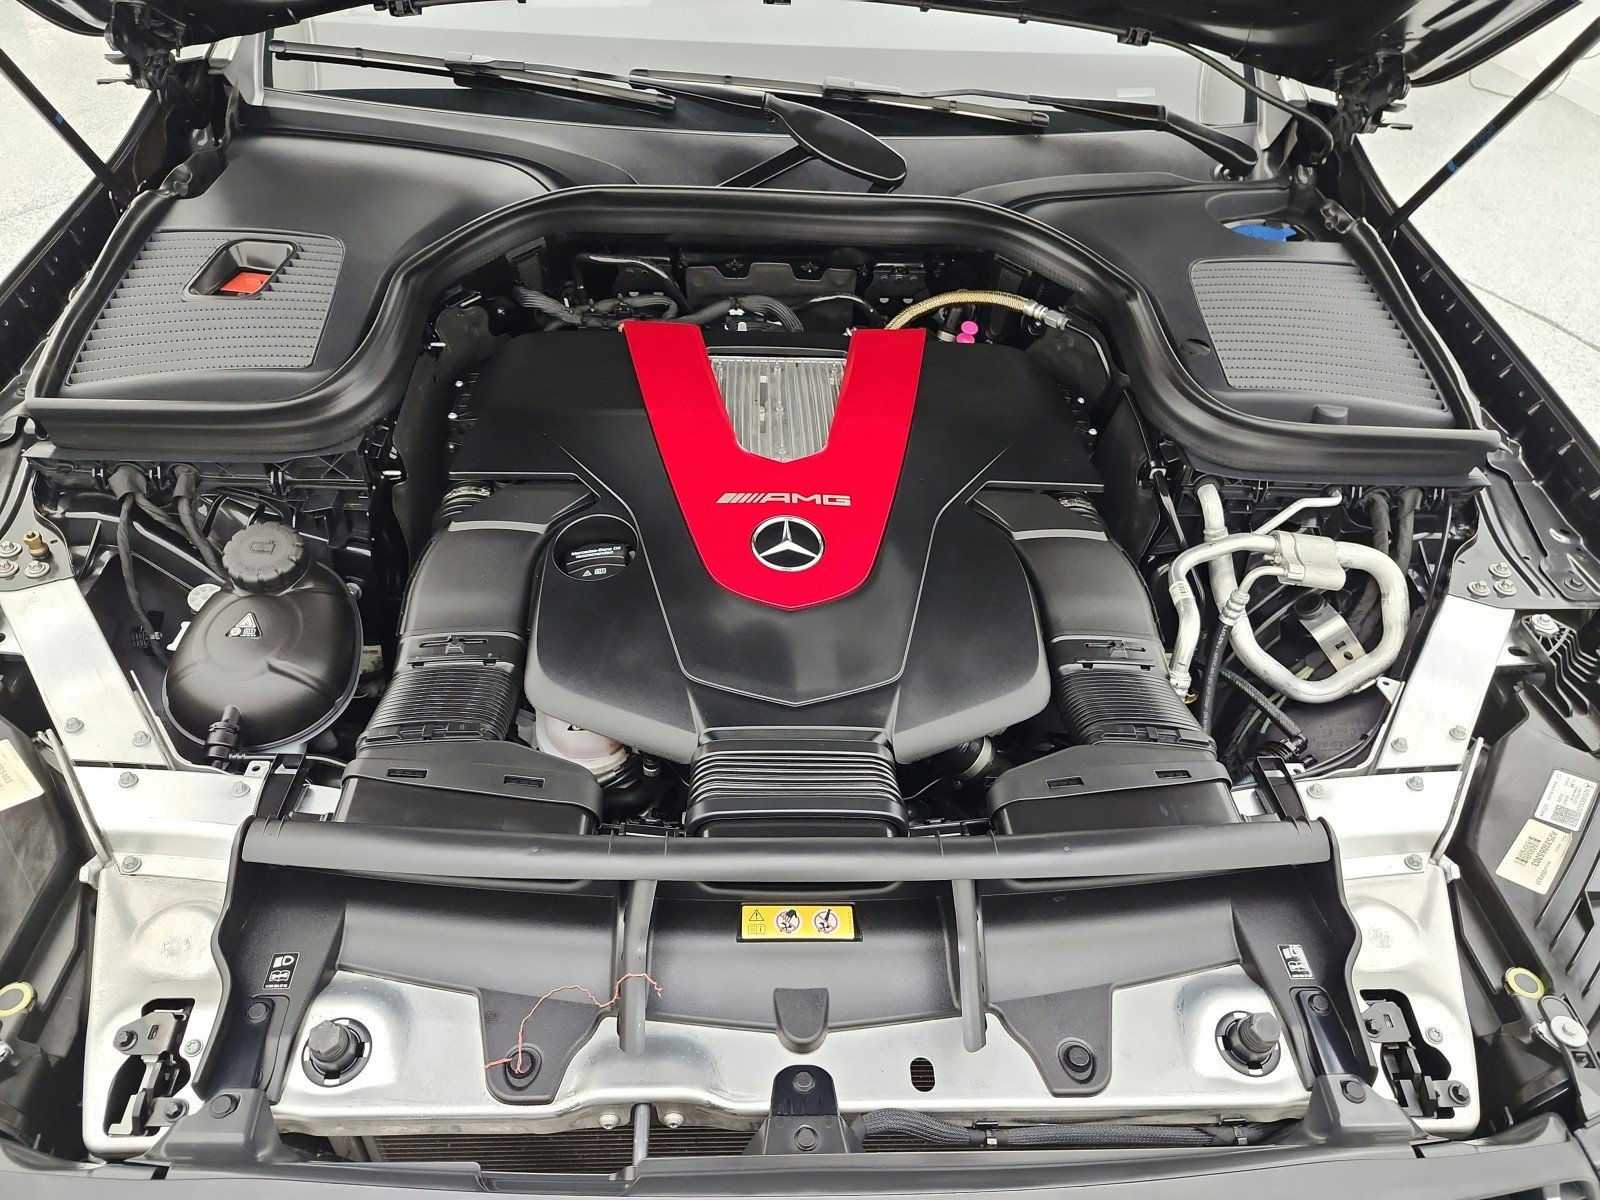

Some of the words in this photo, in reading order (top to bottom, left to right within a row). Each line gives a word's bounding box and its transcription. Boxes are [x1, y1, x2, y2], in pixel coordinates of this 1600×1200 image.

[759, 492, 851, 507] AMG
[571, 547, 612, 556] Mercedes-Benz
[575, 550, 613, 559] recommended
